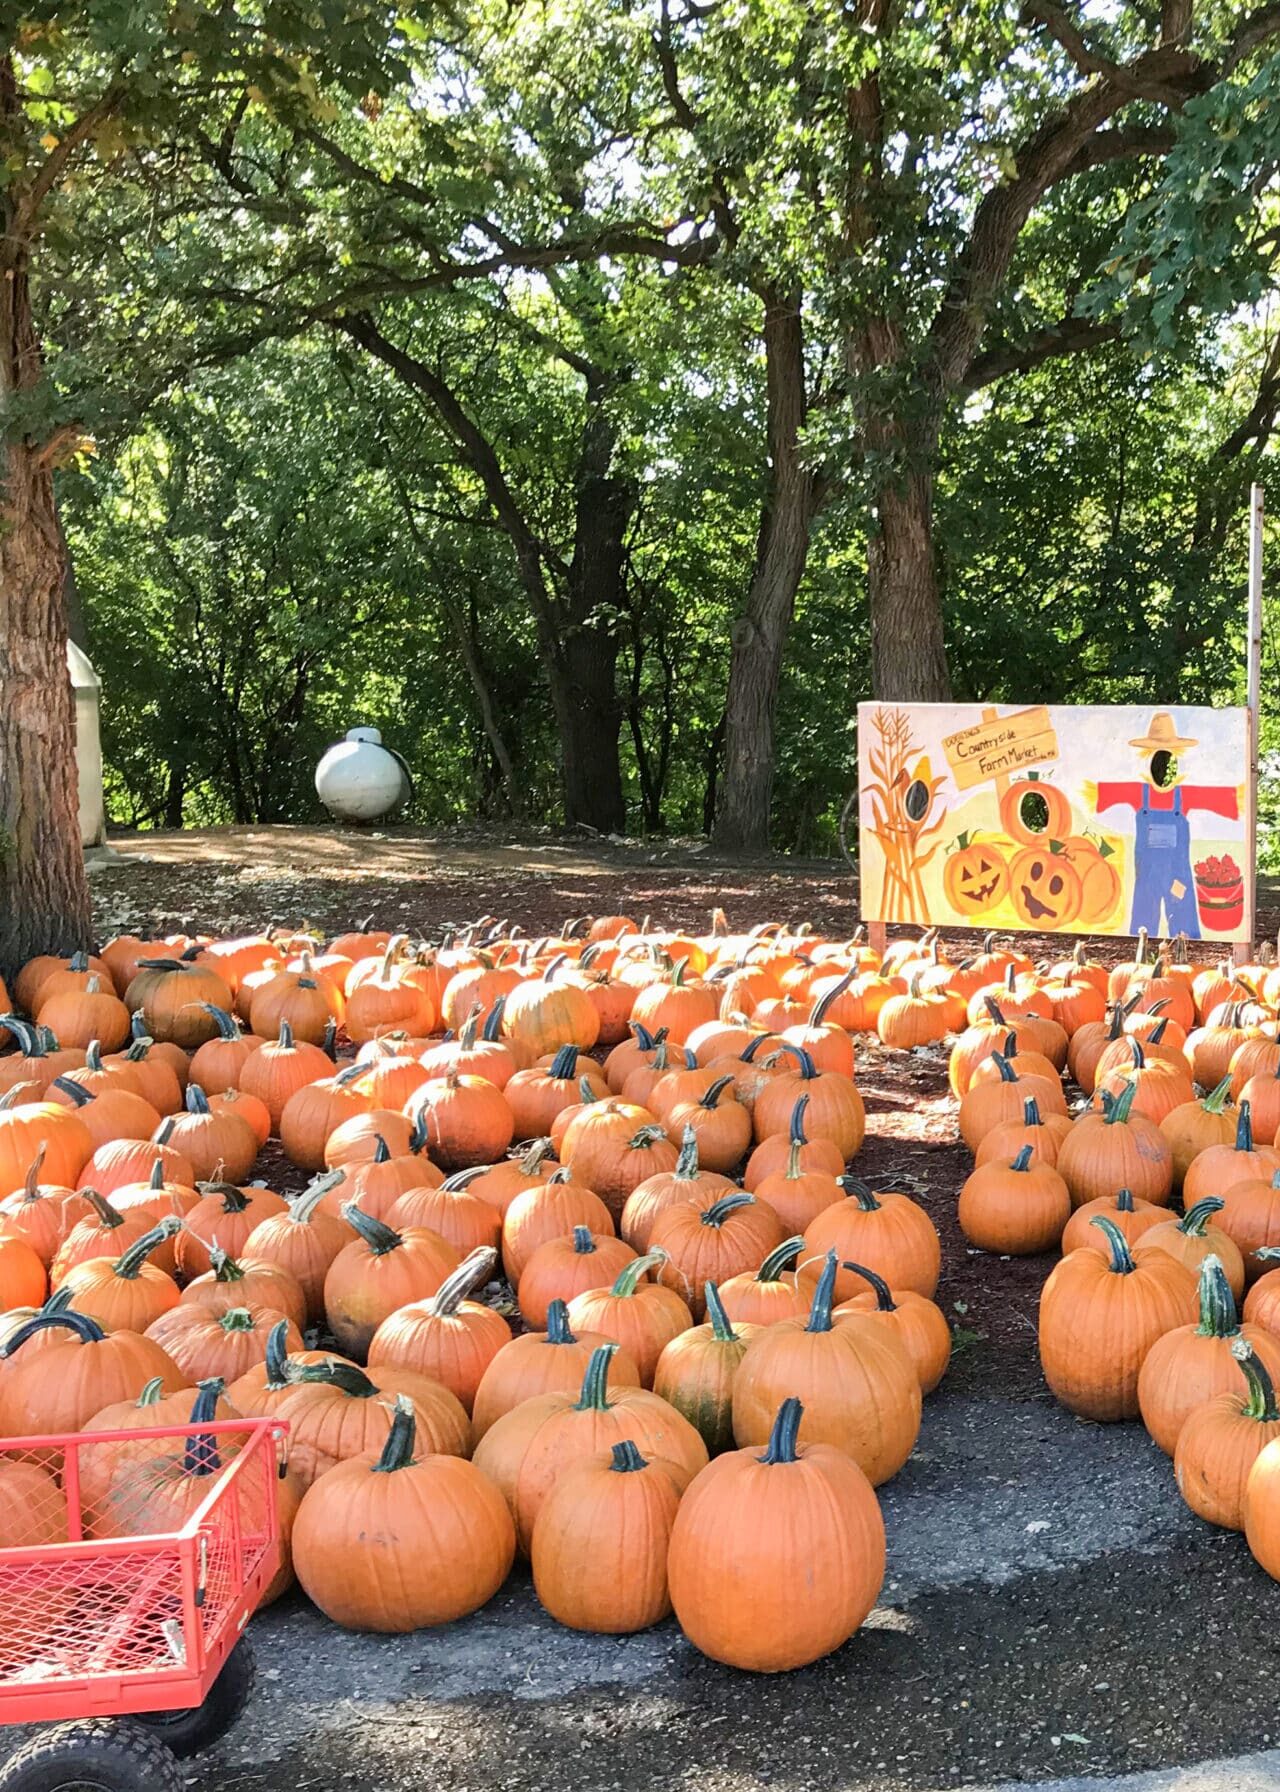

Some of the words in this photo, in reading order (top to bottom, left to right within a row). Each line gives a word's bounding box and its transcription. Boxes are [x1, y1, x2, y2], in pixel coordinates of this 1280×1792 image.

[956, 730, 1016, 757] Countryside
[978, 756, 1008, 774] Farm
[1007, 746, 1038, 764] Market
